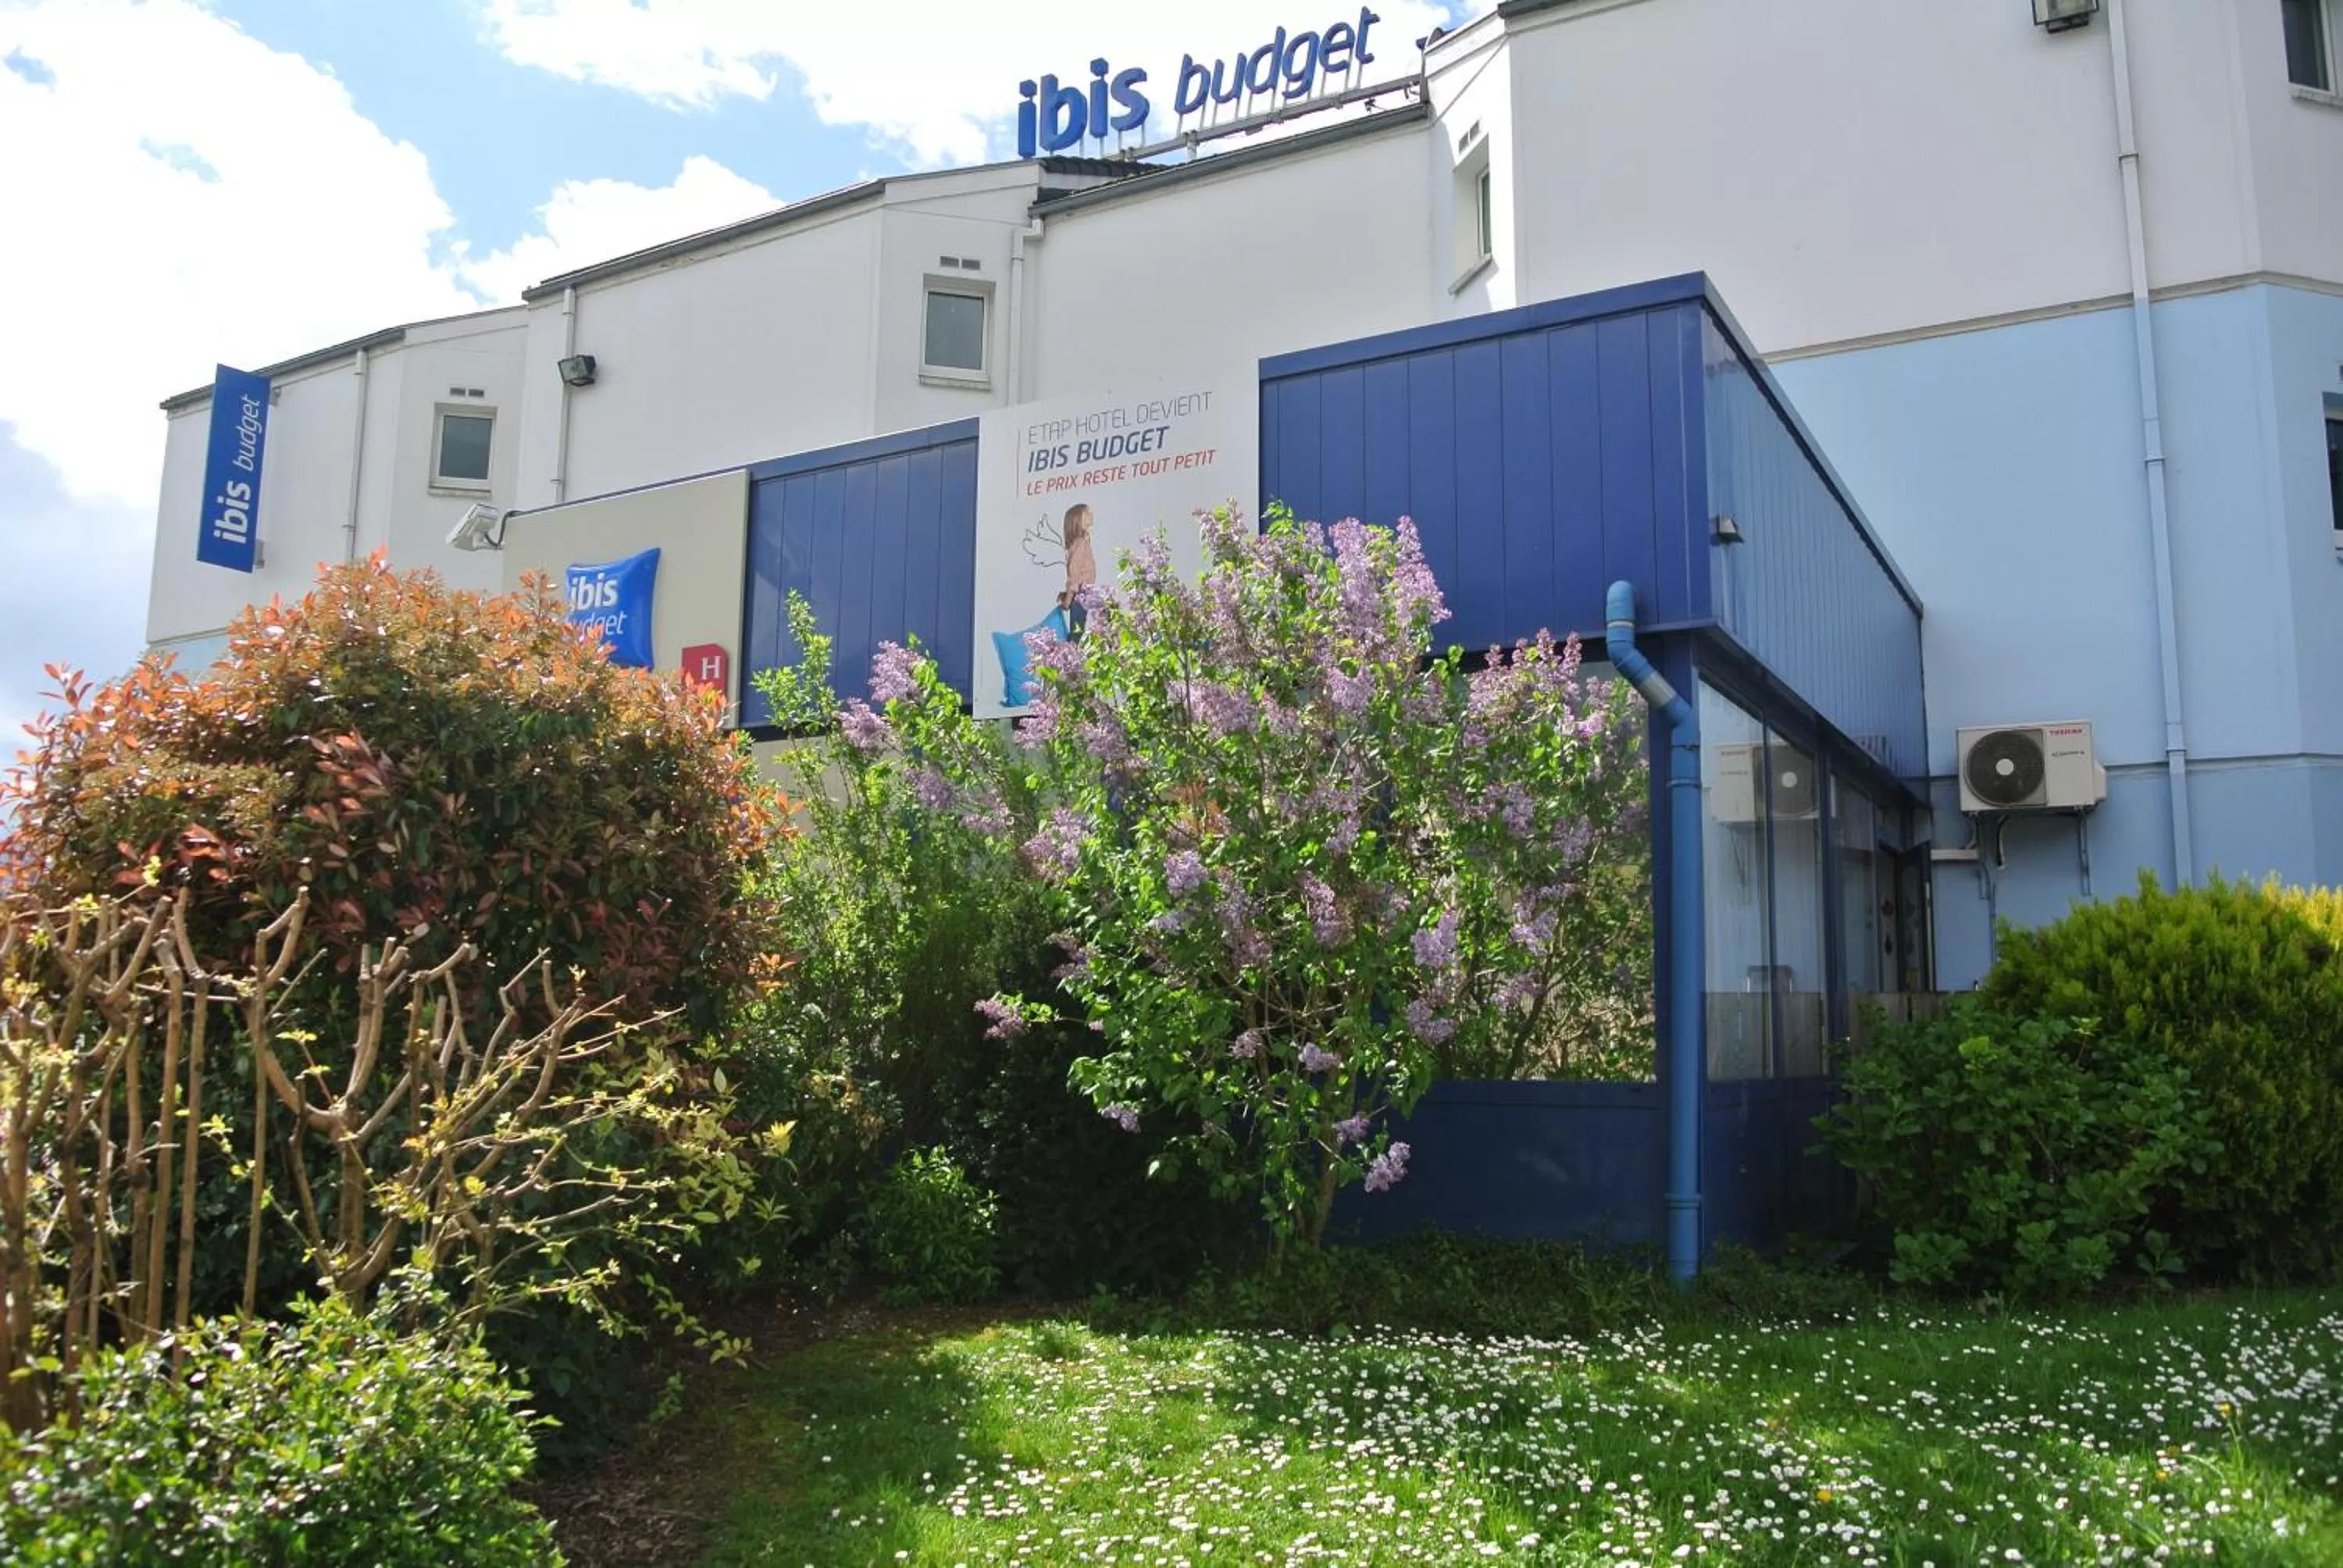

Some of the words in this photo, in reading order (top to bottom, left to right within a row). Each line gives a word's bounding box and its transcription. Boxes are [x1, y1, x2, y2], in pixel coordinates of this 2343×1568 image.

[1018, 57, 1150, 159] ibis
[1174, 5, 1381, 115] budget
[231, 393, 262, 472] budget
[1028, 419, 1072, 444] ETAP
[1075, 408, 1131, 436] HOTEL
[1136, 391, 1213, 425] DEVIENT
[1026, 480, 1043, 497] LE
[1046, 474, 1079, 494] PRIX
[1082, 465, 1126, 486] RESTE
[1132, 456, 1171, 481] TOUT
[1174, 449, 1217, 470] PETIT
[1028, 444, 1070, 473] IBIS
[1076, 425, 1170, 465] BUDGET
[212, 479, 251, 544] ibis
[570, 572, 619, 611] ibis
[701, 655, 721, 680] H
